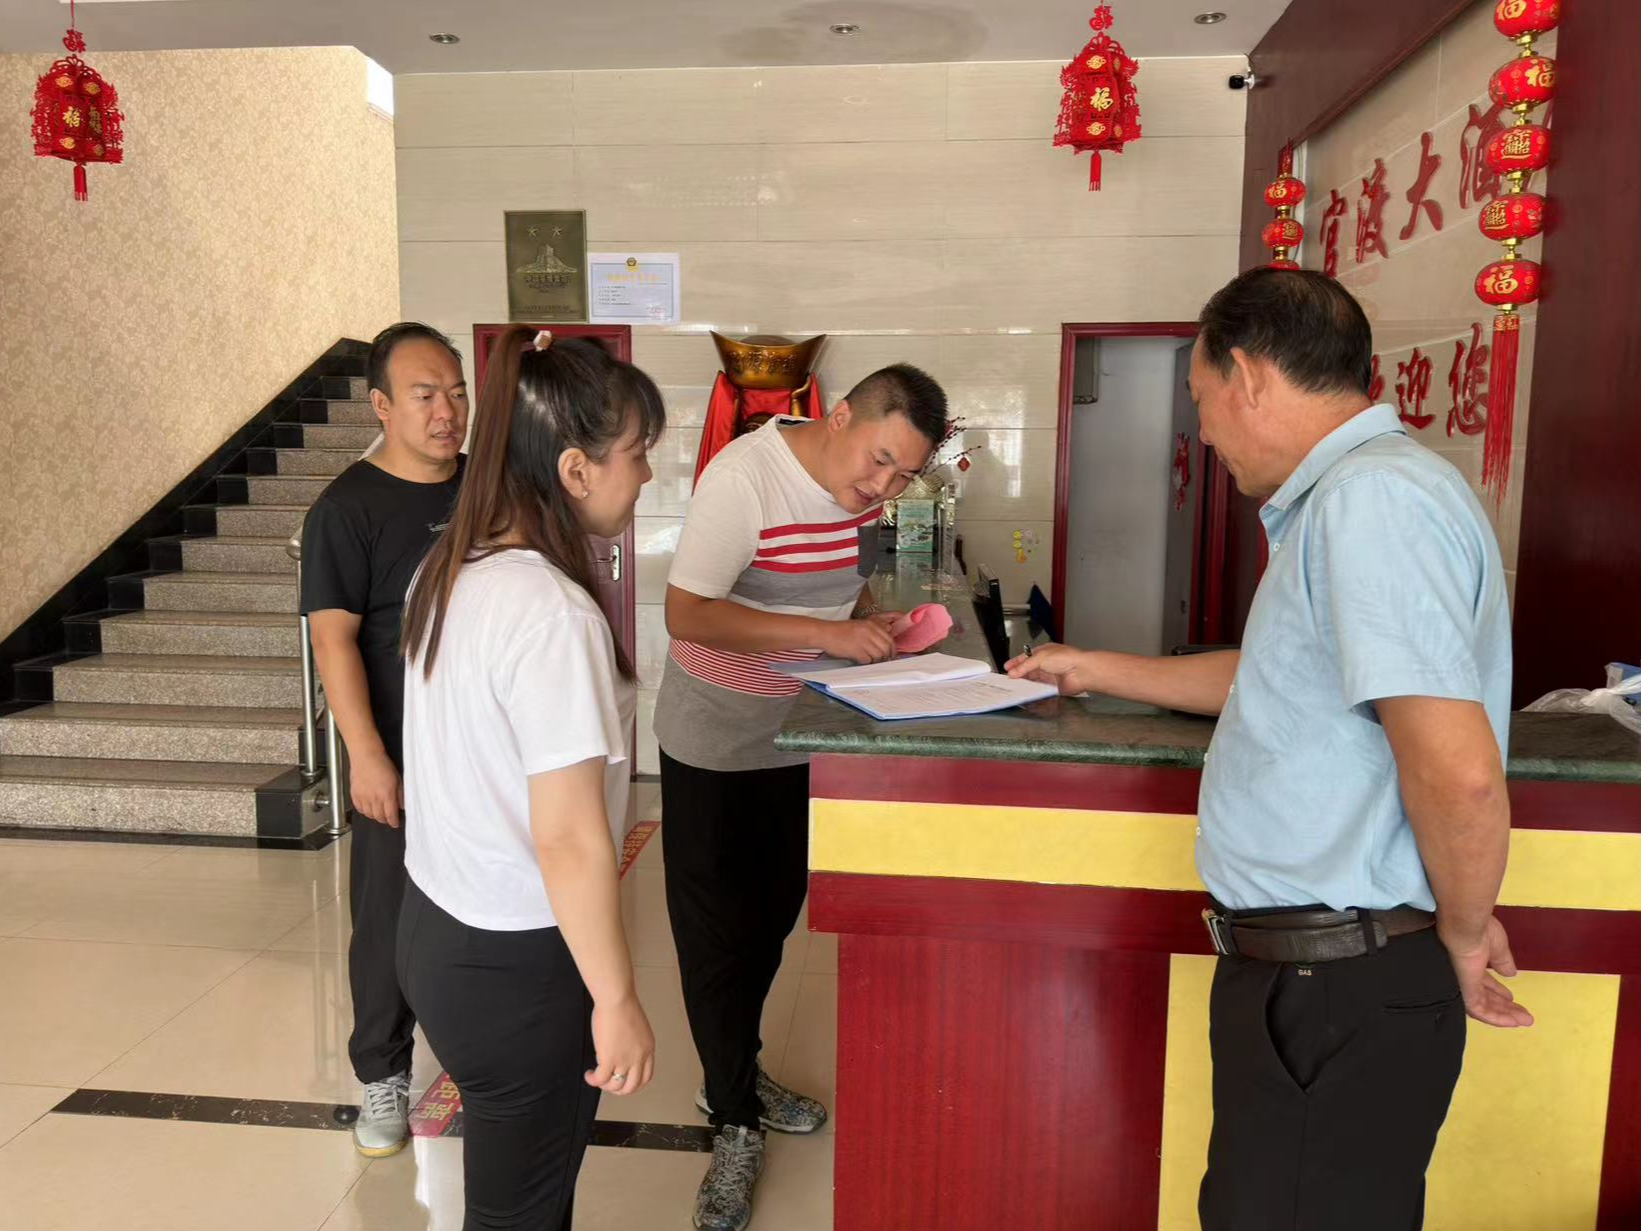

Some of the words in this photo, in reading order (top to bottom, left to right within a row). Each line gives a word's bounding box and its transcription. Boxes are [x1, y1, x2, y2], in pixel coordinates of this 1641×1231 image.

[1525, 59, 1556, 88] 福
[1089, 86, 1114, 112] 福
[1319, 100, 1548, 278] 官渡大酒
[1482, 264, 1519, 295] 福
